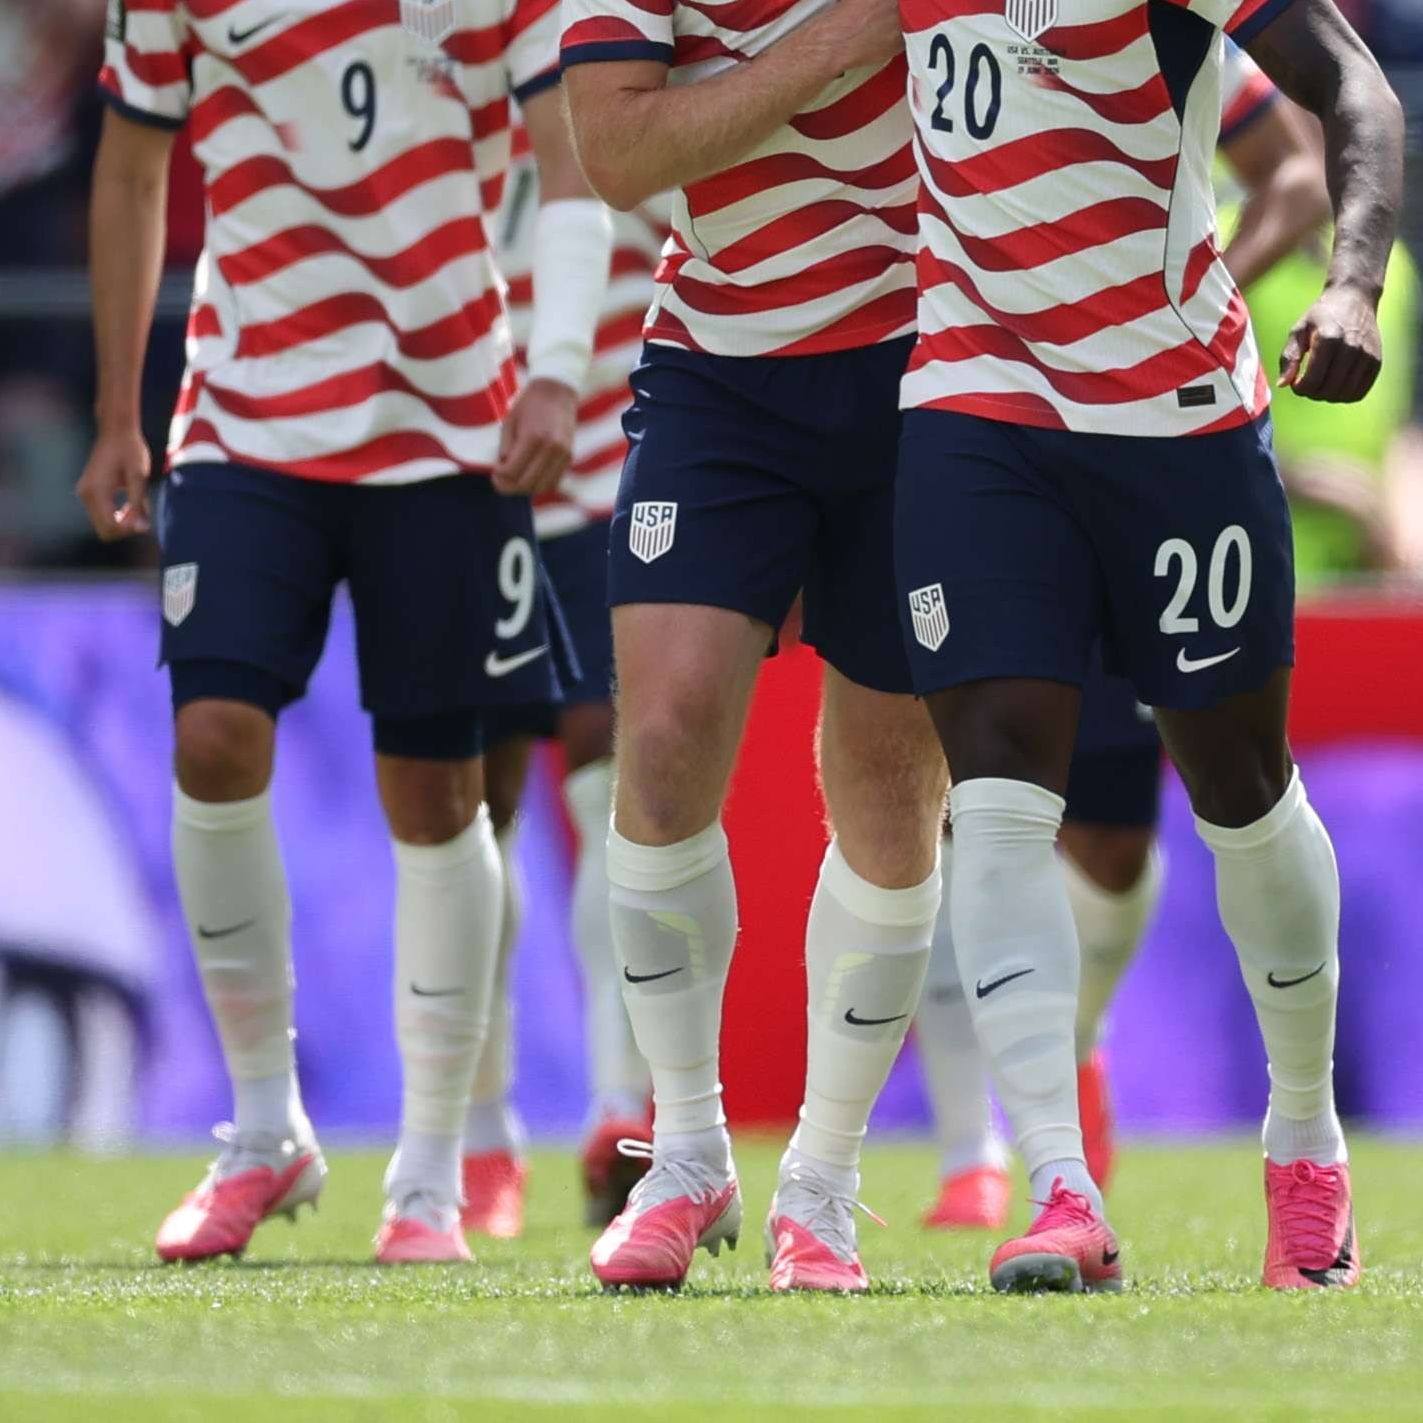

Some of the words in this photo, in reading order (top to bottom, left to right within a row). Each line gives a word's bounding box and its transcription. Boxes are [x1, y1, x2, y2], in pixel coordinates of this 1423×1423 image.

[341, 61, 375, 153] 9
[928, 33, 1002, 140] 20
[635, 505, 674, 527] USA
[495, 537, 534, 638] 9
[911, 587, 941, 615] USA
[1154, 524, 1252, 634] 20
